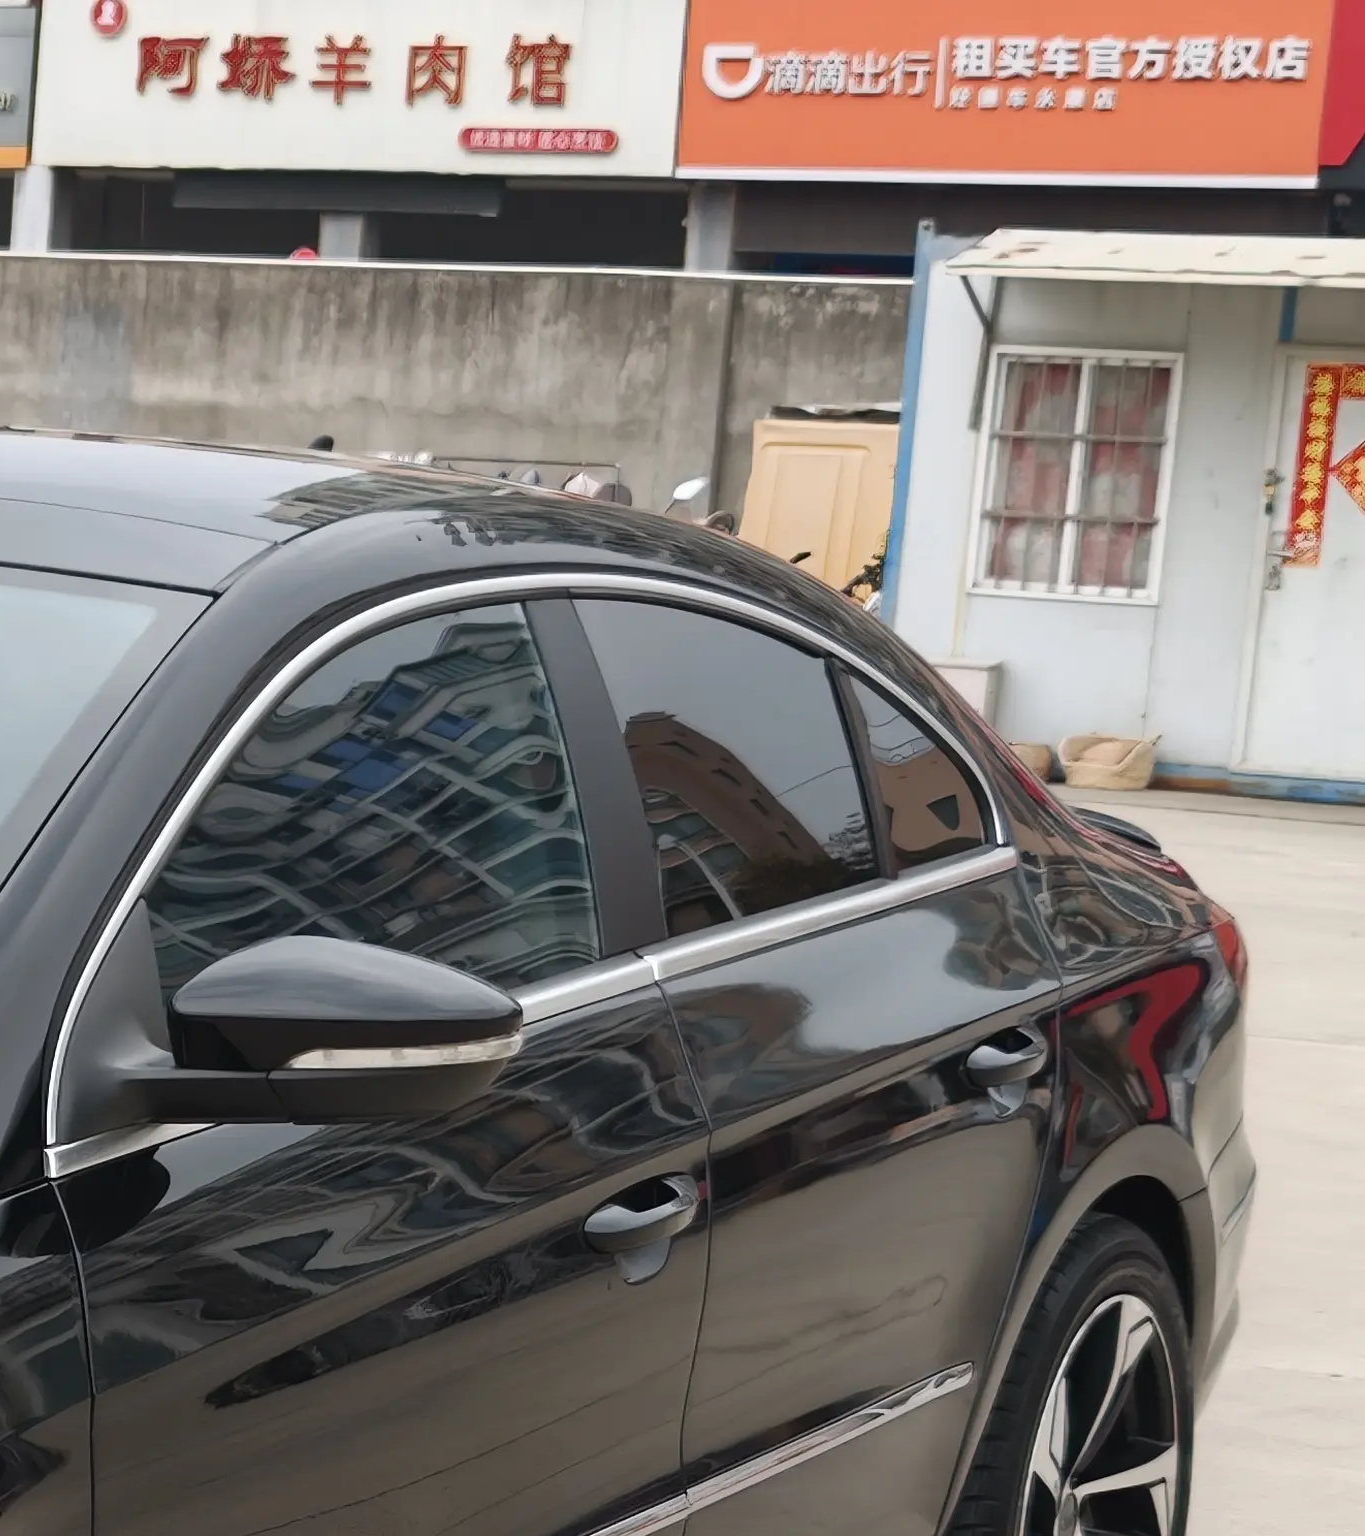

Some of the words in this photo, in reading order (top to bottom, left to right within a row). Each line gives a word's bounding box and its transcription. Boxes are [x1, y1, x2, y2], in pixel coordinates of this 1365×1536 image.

[764, 49, 931, 97] 滴滴出行
[953, 34, 1311, 82] 租买车官方授权店
